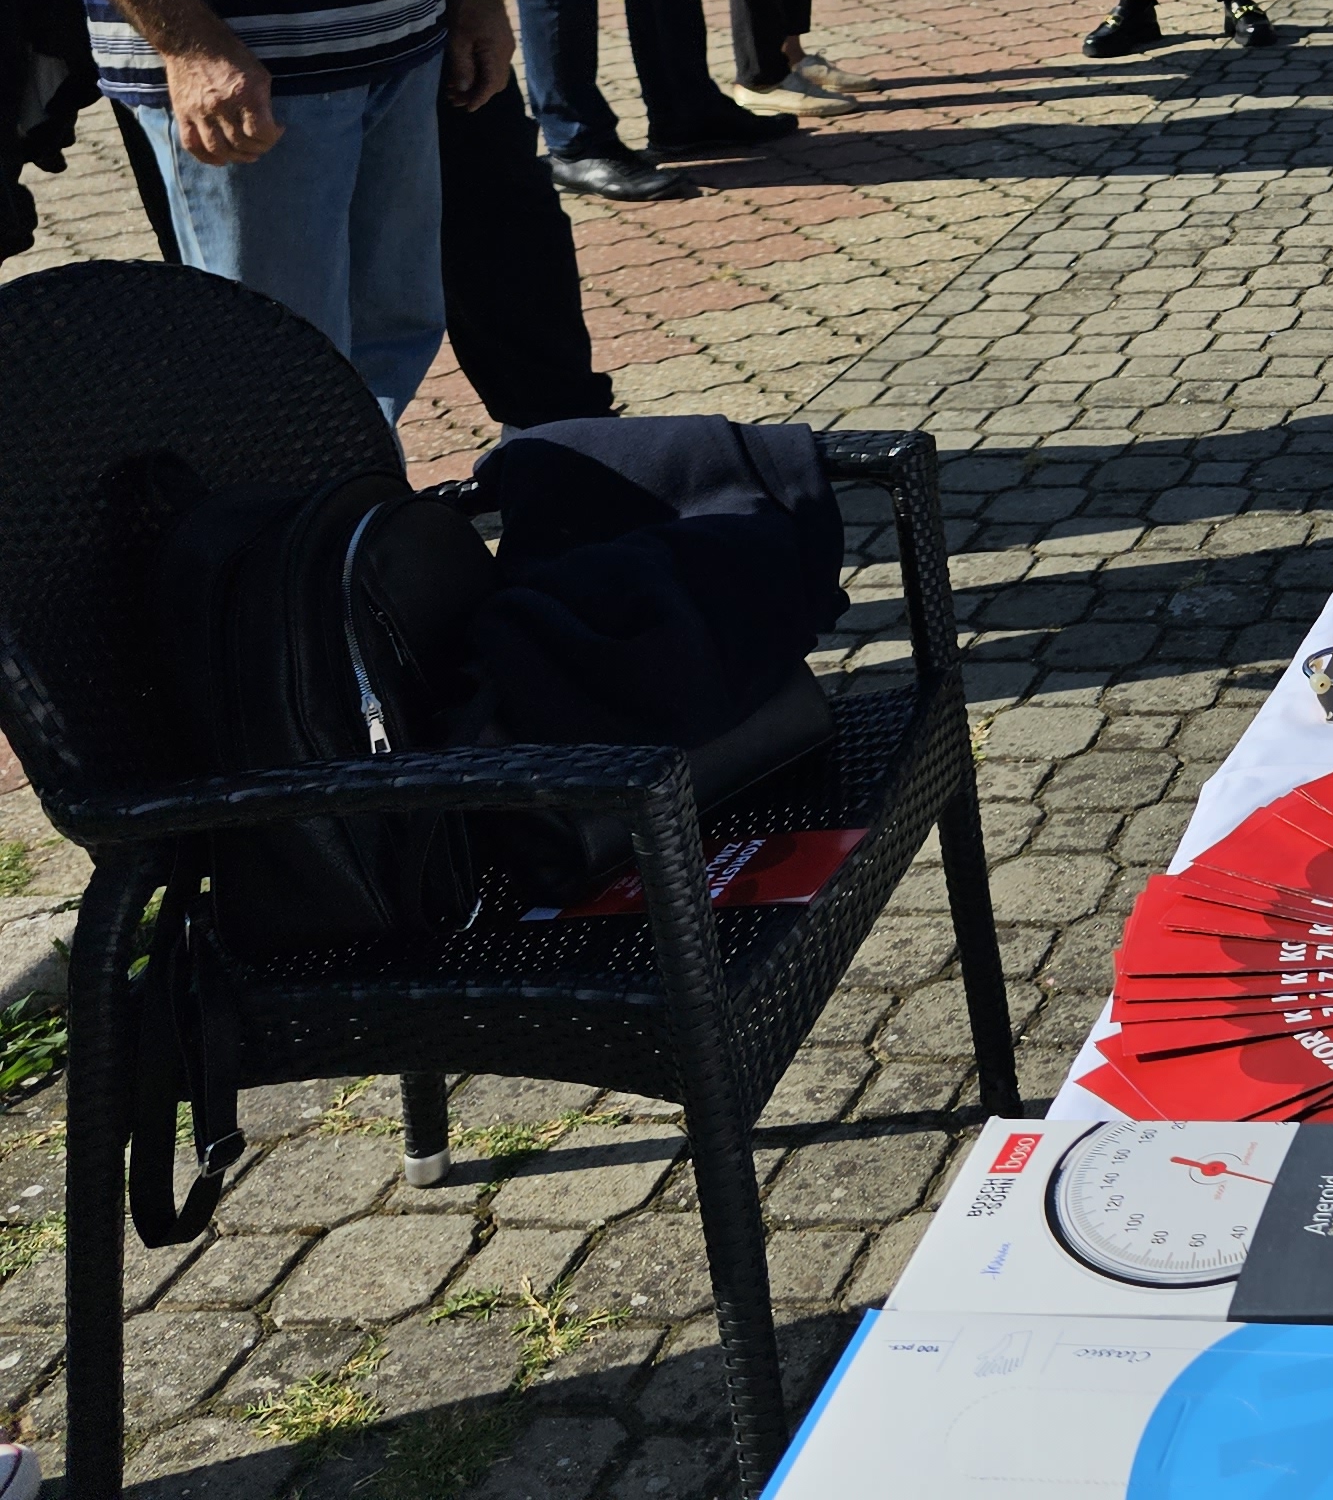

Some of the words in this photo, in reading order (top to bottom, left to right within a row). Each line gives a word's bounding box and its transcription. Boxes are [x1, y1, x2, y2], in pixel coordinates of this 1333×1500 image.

[705, 841, 744, 872] ZNAJ
[711, 839, 767, 887] KORISTI
[1137, 1128, 1158, 1145] 180
[995, 1137, 1036, 1170] boso
[1111, 1148, 1132, 1165] 160
[1100, 1172, 1120, 1190] 140
[966, 1178, 1001, 1218] BOSCH
[986, 1178, 1017, 1216] +SOHN
[1104, 1194, 1125, 1213] 120
[1124, 1213, 1145, 1233] 100
[1151, 1230, 1169, 1245] 80
[1189, 1233, 1207, 1248] 60
[1231, 1225, 1248, 1240] 40
[1075, 1347, 1152, 1364] Classic
